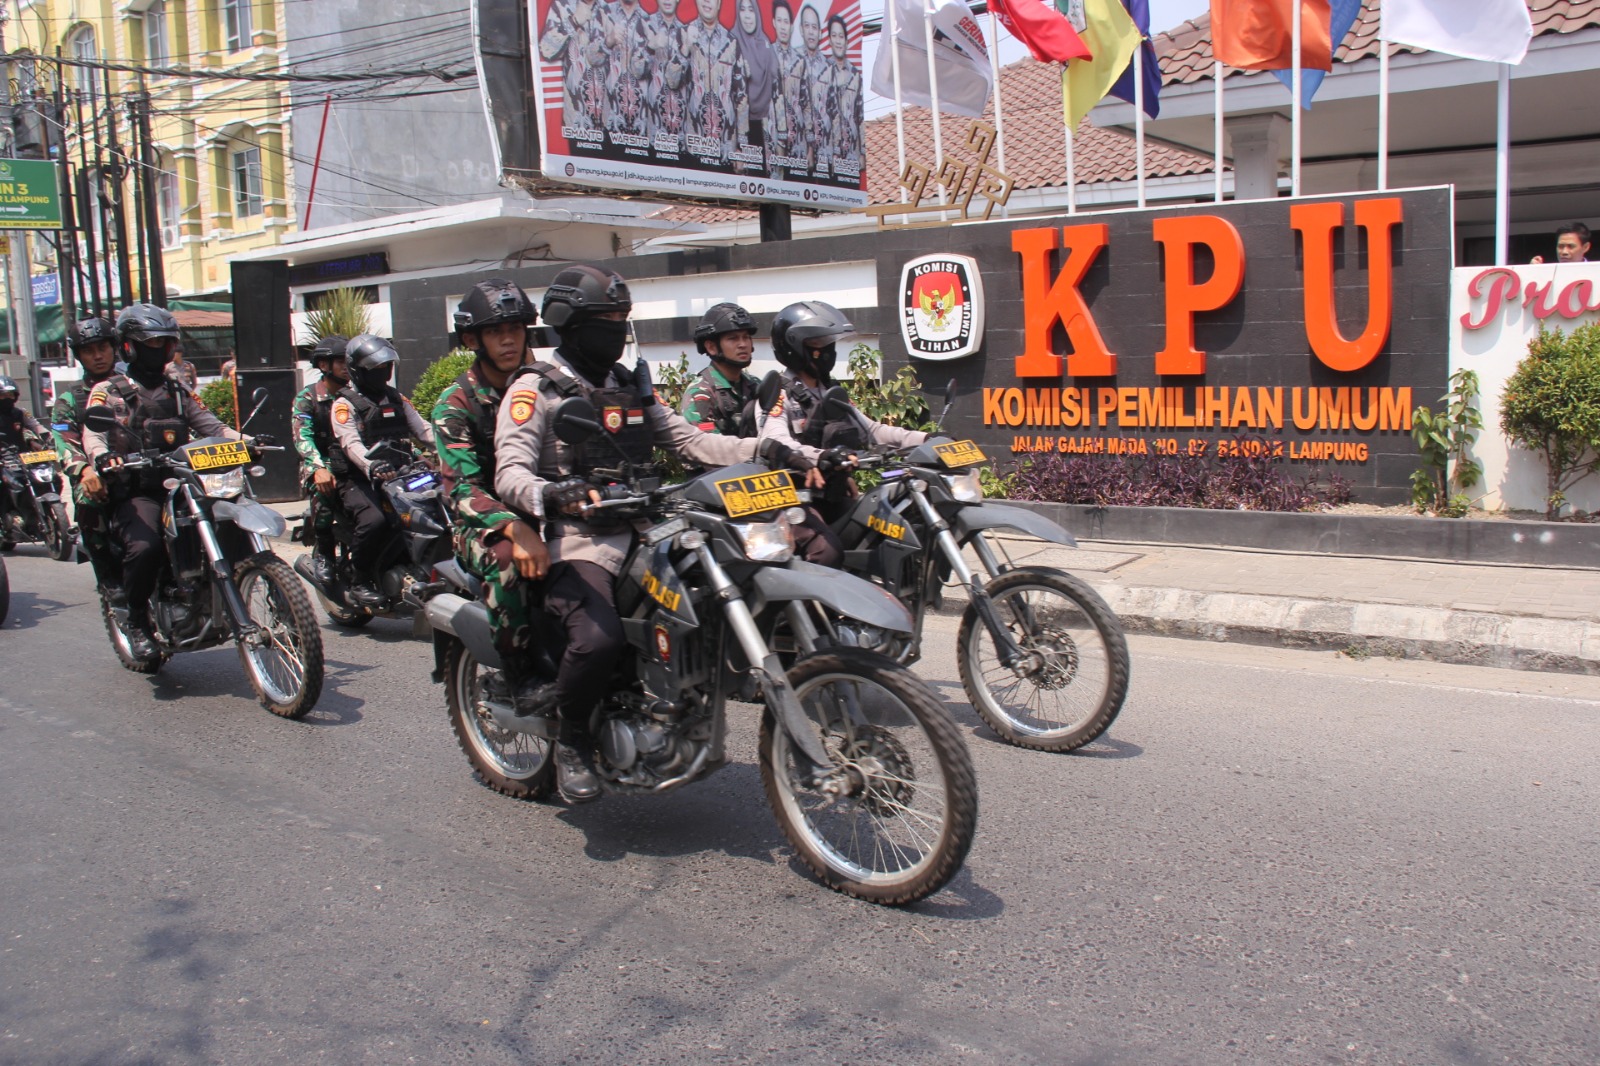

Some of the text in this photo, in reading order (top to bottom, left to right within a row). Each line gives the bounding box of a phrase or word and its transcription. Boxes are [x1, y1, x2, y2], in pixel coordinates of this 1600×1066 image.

[562, 126, 604, 142] ISMANTO
[609, 131, 650, 148] WARSITO
[655, 131, 679, 144] AGUS
[686, 133, 720, 148] ERWAN
[17, 183, 29, 195] 3
[4, 196, 50, 204] LAMPUNG
[914, 262, 958, 277] KOMISI
[1011, 197, 1403, 378] KPU
[961, 301, 971, 338] UMUM
[920, 340, 960, 352] LIHAN
[983, 386, 1412, 431] KOMISI PEMILIHAN UMUM
[214, 444, 238, 455] XXV
[1011, 435, 1054, 453] JALAN
[1058, 436, 1104, 454] GAJAH
[1107, 437, 1148, 455] MADA
[1289, 441, 1369, 462] LAMPUNG
[866, 515, 906, 541] POLISI
[641, 568, 681, 612] POLISI
